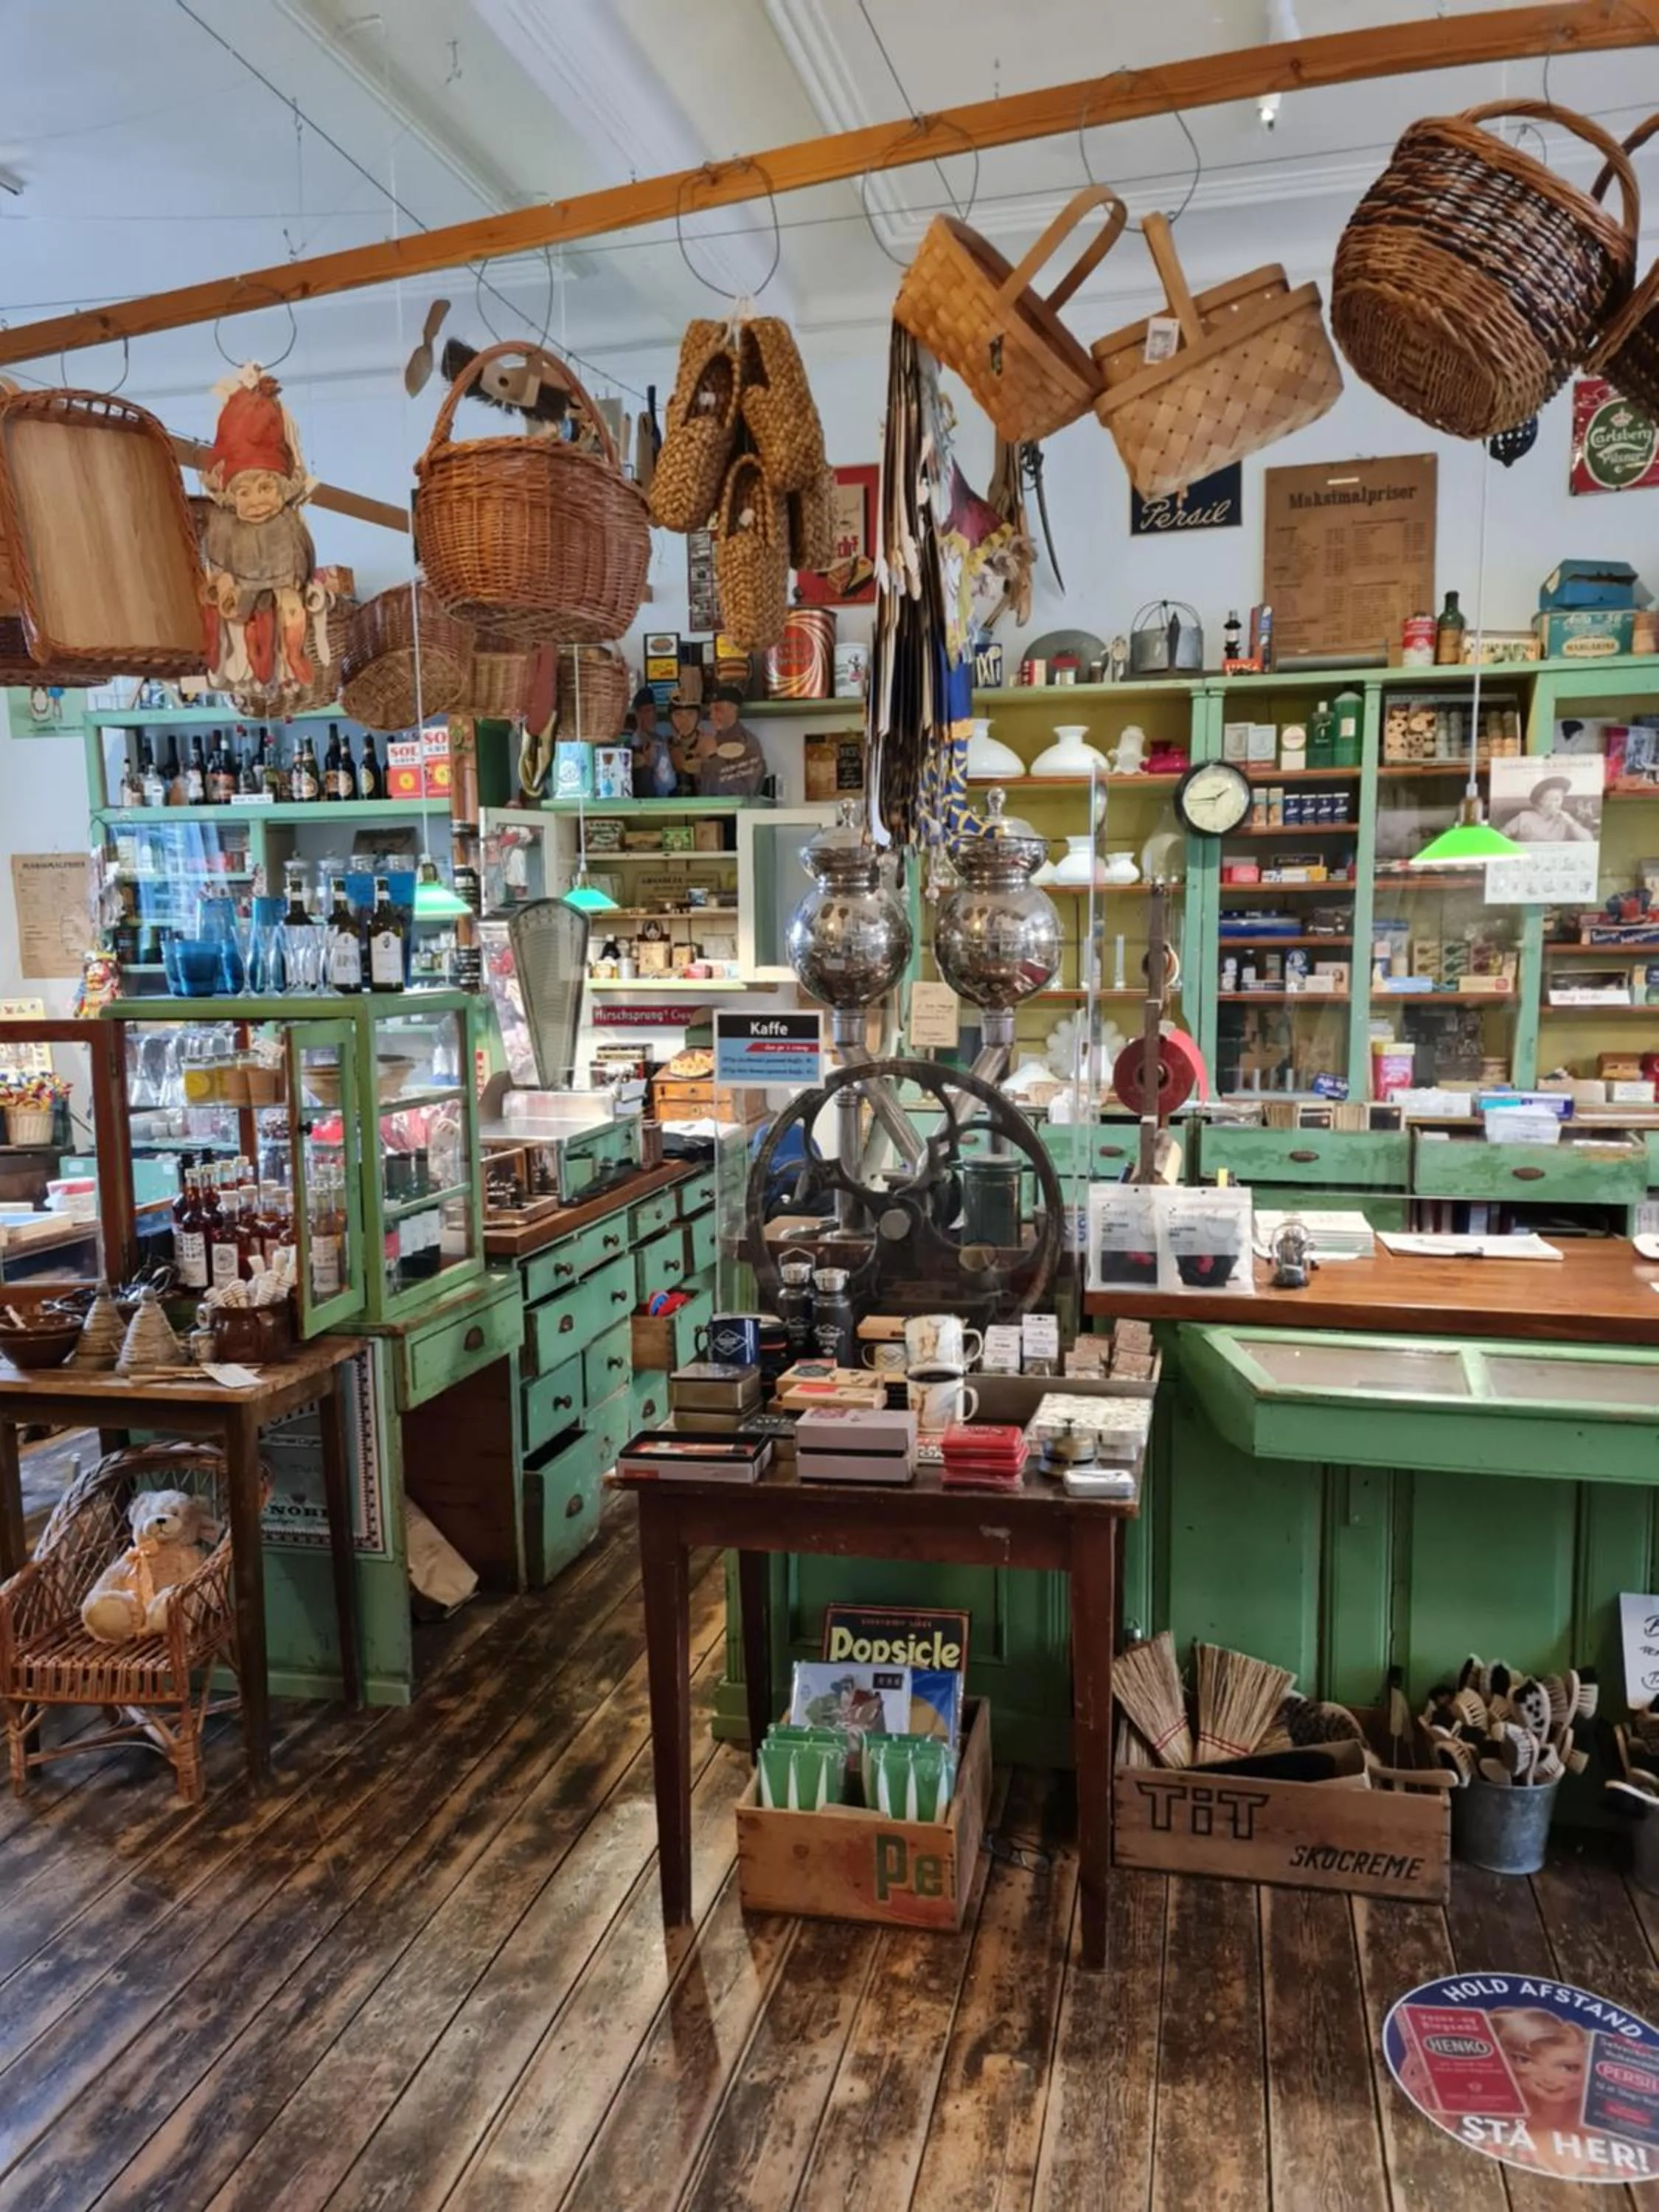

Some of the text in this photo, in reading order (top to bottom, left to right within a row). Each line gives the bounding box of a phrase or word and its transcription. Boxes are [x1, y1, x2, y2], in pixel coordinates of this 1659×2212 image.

[1590, 425, 1652, 451] Carlsberg
[1289, 484, 1417, 509] Maksimalpriser
[1140, 498, 1231, 529] Persil
[424, 731, 448, 745] SO
[749, 1021, 789, 1035] Kaffe
[830, 1627, 961, 1669] Popsicle
[1135, 1781, 1270, 1840] TiT
[876, 1833, 956, 1901] Pe
[1442, 1978, 1644, 2038] HOLD AFSTAND
[1428, 2037, 1488, 2053] HENKO
[1461, 2115, 1650, 2174] STÅ HER!
